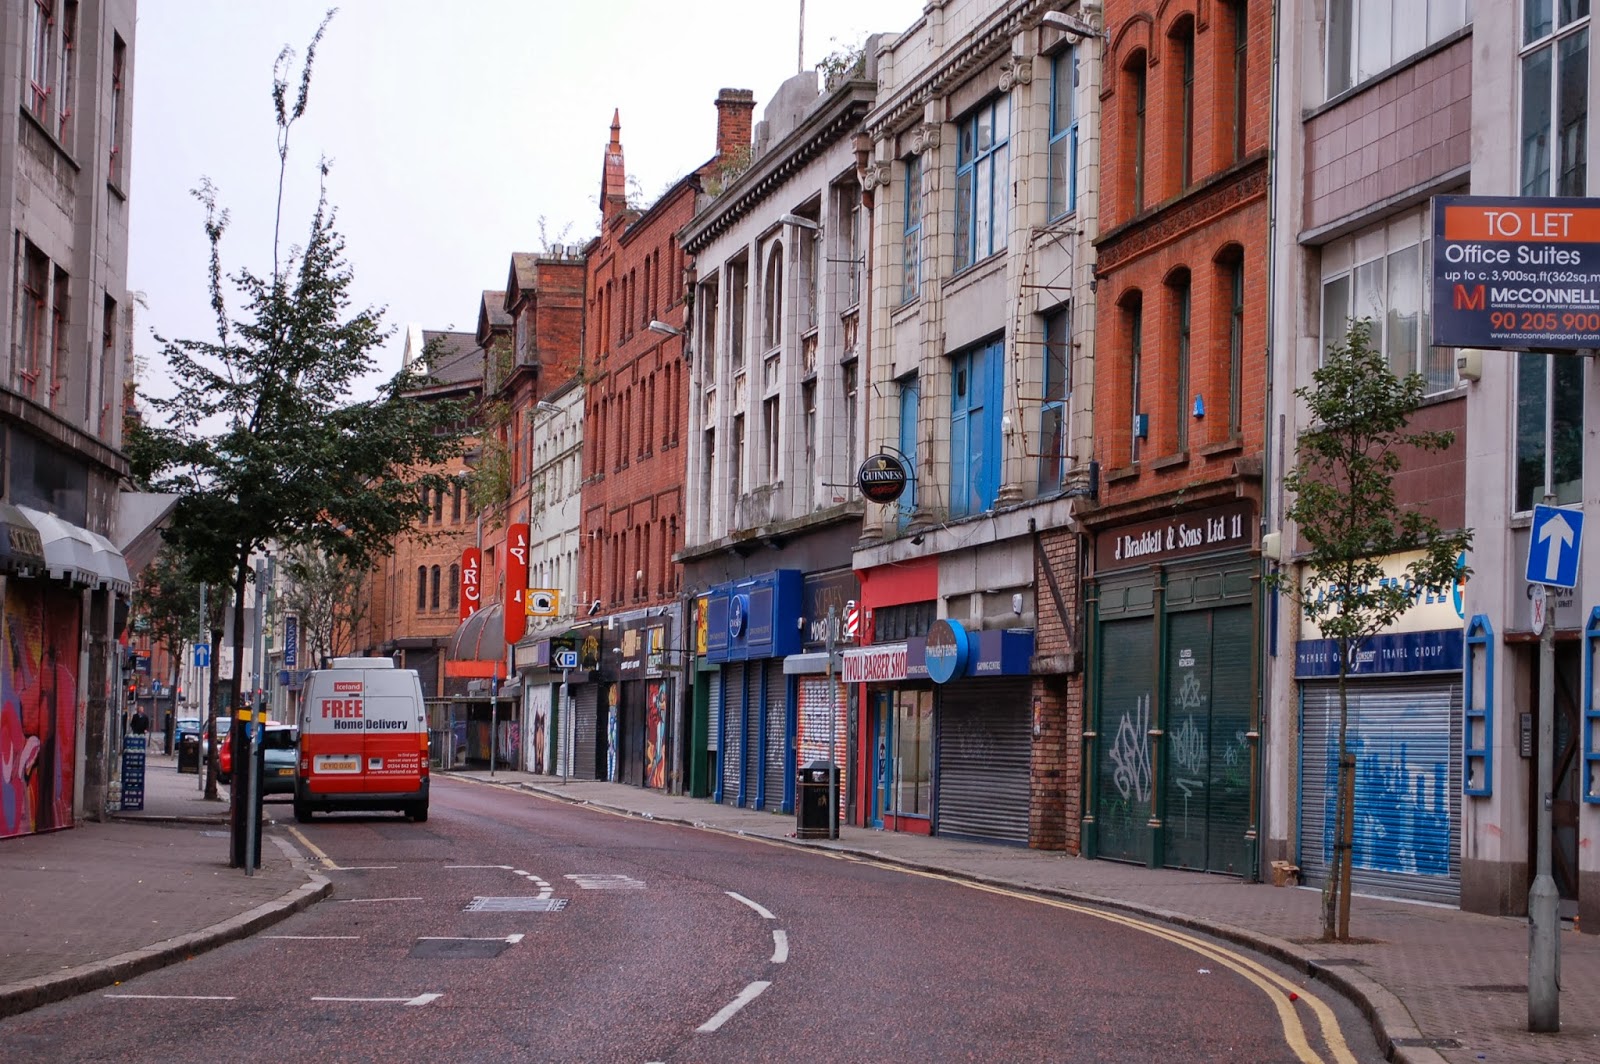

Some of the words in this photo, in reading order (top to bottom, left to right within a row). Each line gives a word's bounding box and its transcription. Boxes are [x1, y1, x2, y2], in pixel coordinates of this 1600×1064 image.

[1484, 211, 1522, 236] TO
[1531, 212, 1574, 237] LET
[1445, 244, 1510, 263] Office
[1517, 245, 1581, 265] Suites
[1445, 271, 1460, 282] up
[1464, 270, 1476, 280] to
[1479, 271, 1489, 280] c.
[1454, 284, 1486, 310] M
[1490, 311, 1516, 330] 90
[1521, 312, 1558, 331] 205
[1490, 332, 1600, 341] www.mcconnellproperty.com
[861, 470, 903, 481] GUINNESS
[1124, 529, 1162, 559] Braddell
[1166, 525, 1176, 550] &
[1179, 523, 1202, 548] Sons
[1207, 515, 1226, 543] Ltd.
[1232, 514, 1242, 539] 11
[566, 654, 575, 665] P
[1356, 650, 1377, 660] CONSORT
[1383, 648, 1408, 659] TRAVEL
[844, 655, 863, 681] TIVOLI
[864, 653, 890, 680] BARBER
[321, 699, 363, 718] FREE
[334, 719, 363, 730] Home
[366, 719, 408, 730] Delivery
